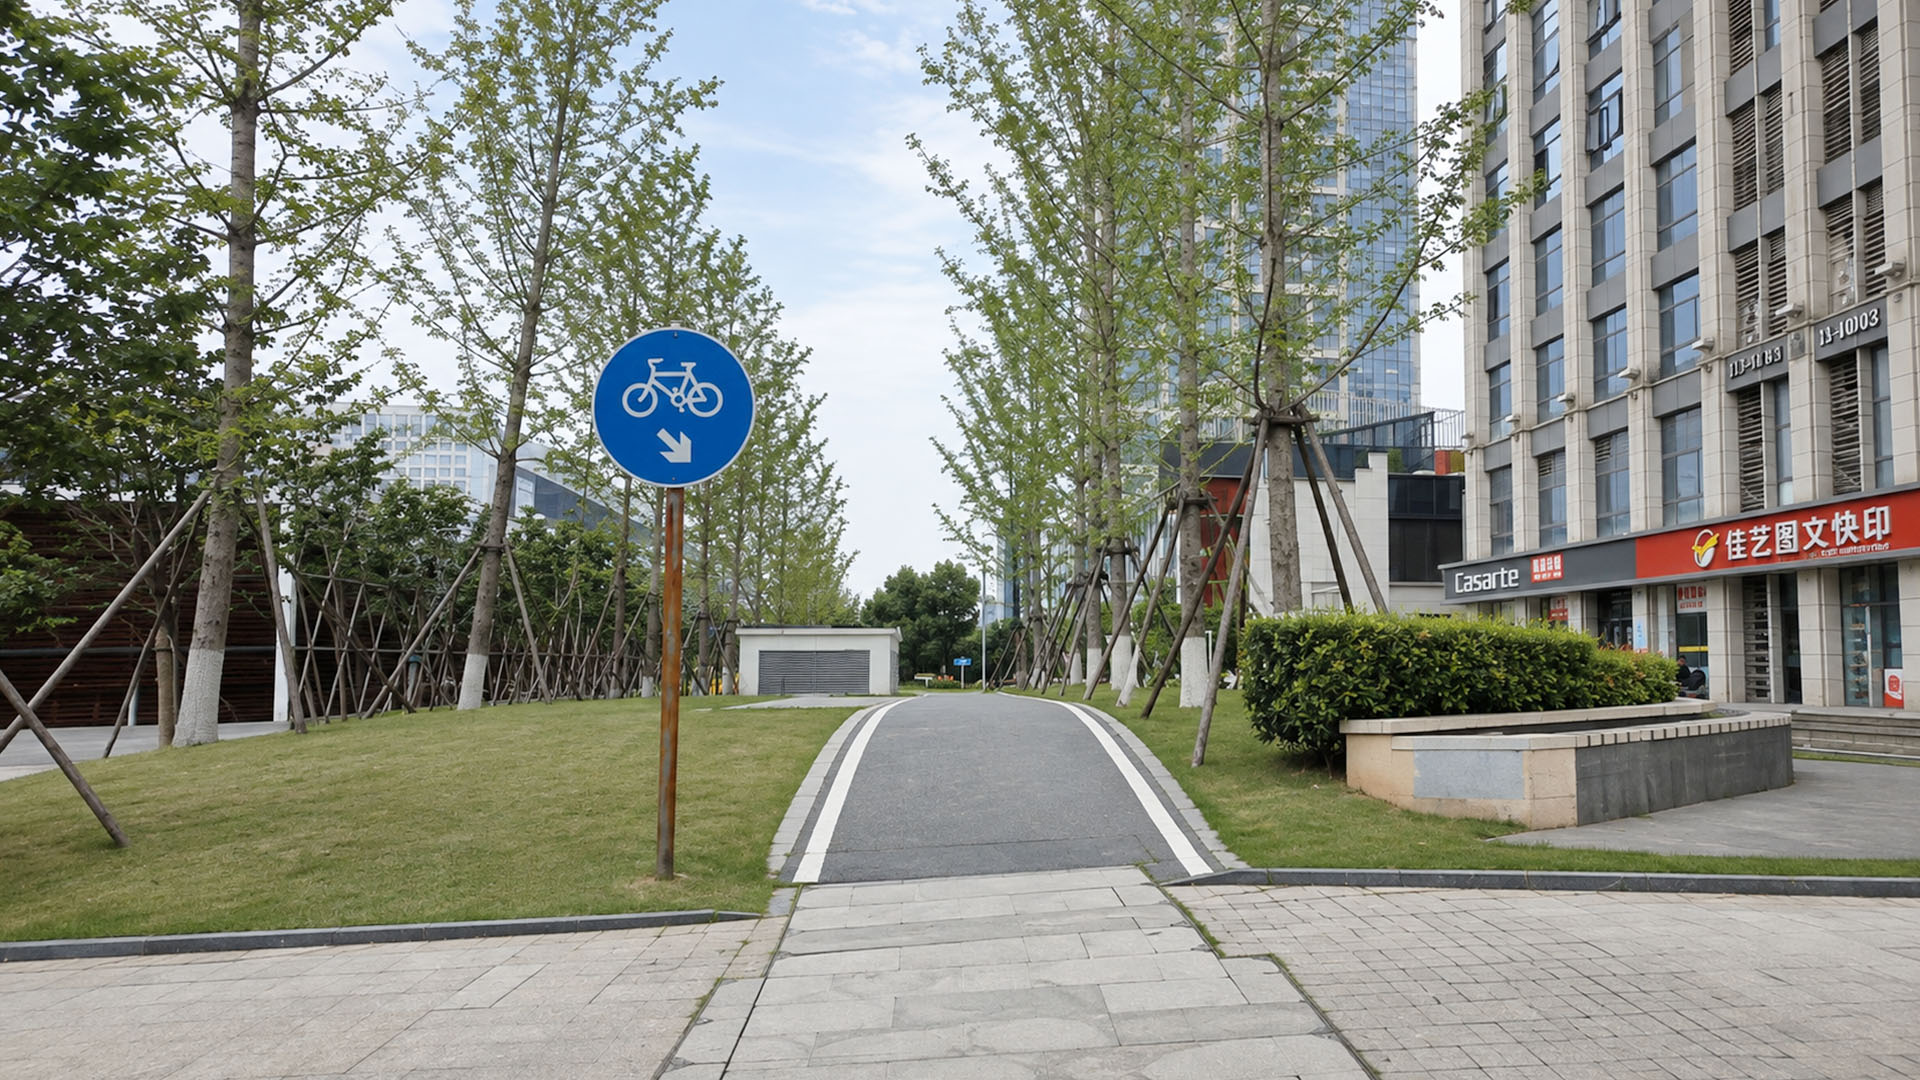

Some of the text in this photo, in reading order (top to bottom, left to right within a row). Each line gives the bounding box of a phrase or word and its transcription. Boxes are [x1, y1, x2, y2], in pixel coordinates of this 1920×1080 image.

[1725, 505, 1891, 561] 佳艺图文快印
[1455, 567, 1519, 593] Casarte
